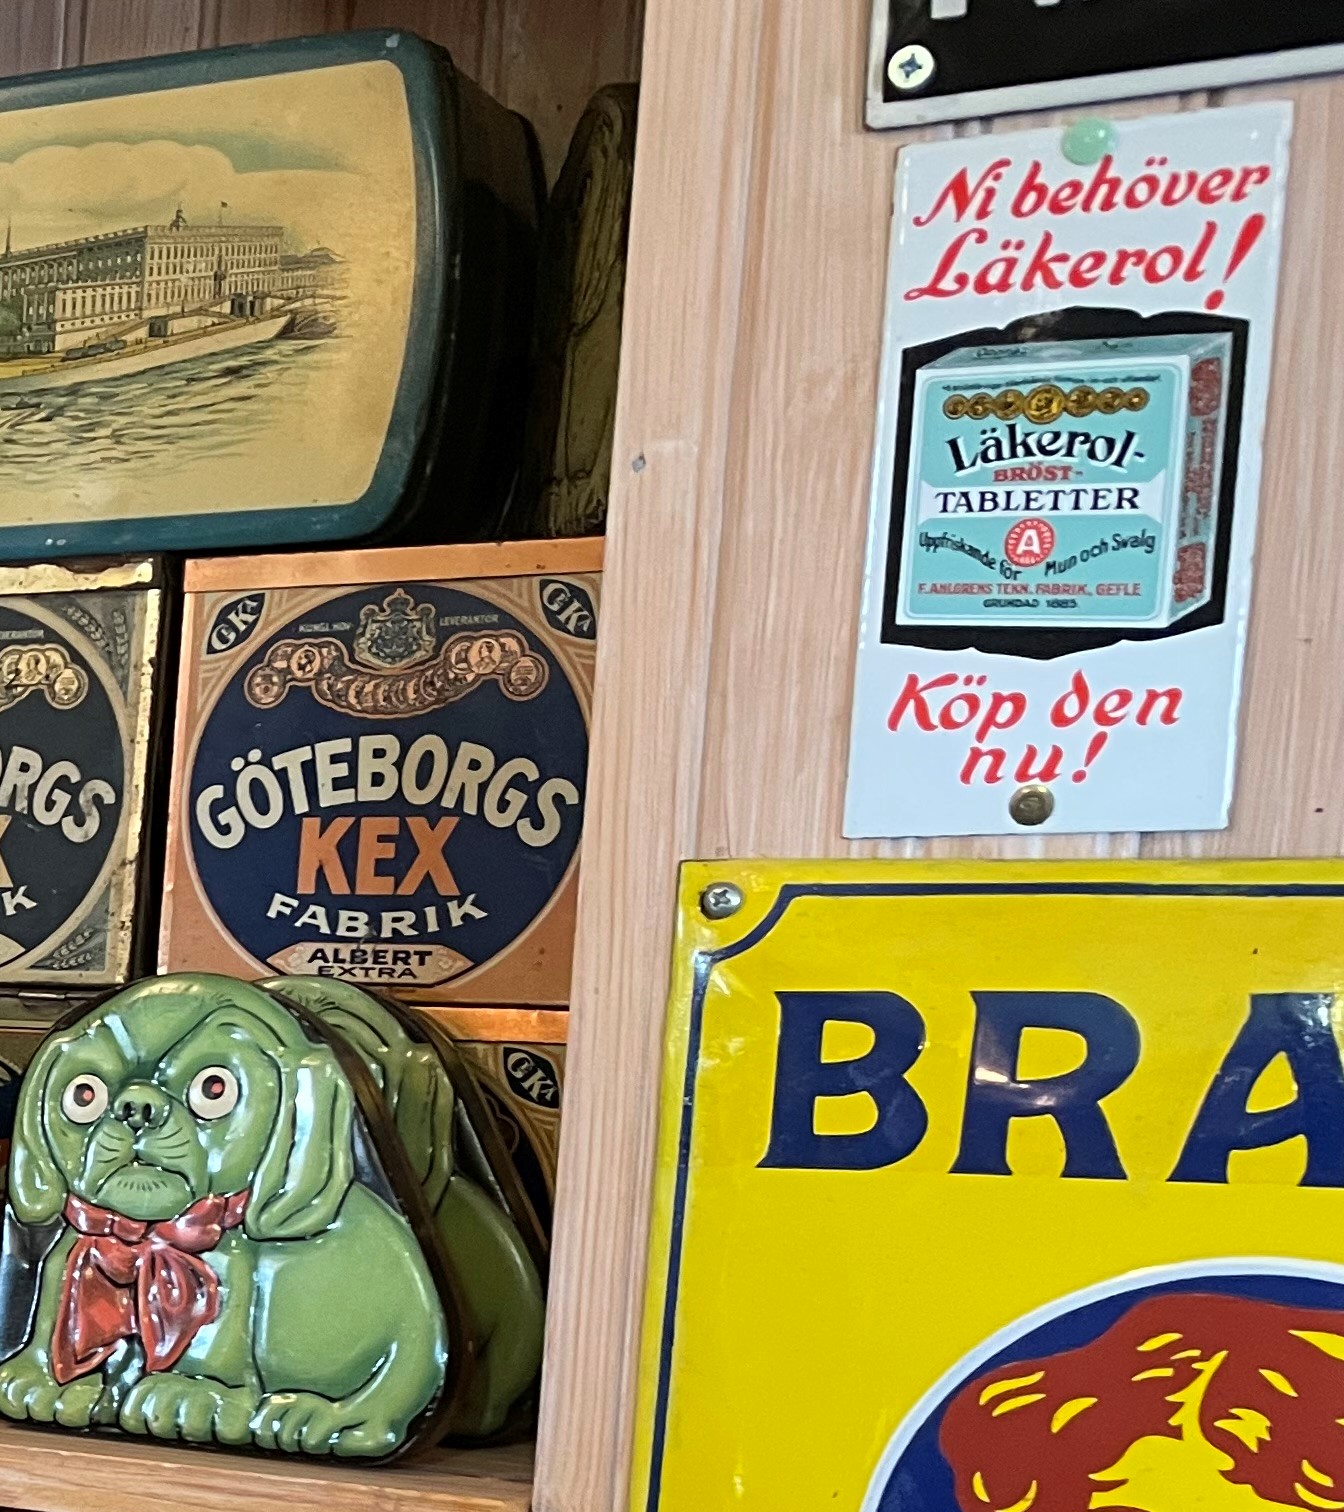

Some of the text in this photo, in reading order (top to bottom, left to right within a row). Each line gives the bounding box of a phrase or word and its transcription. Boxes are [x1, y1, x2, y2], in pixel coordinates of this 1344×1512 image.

[912, 154, 1272, 229] Ni behöver
[904, 213, 1268, 313] Läkerol!
[944, 423, 1146, 475] Läkerol-
[993, 461, 1084, 483] BRÖST-
[935, 487, 1140, 514] TABLETTER
[999, 560, 1023, 581] för
[1044, 557, 1078, 578] Mun
[1080, 538, 1110, 563] och
[1016, 529, 1042, 556] A
[1095, 582, 1141, 595] GEFLE
[887, 670, 1184, 743] Köp den
[960, 731, 1109, 786] nu!
[194, 733, 580, 849] GÖTEBORGS
[297, 816, 461, 897] KEX
[265, 892, 489, 939] FABRIK
[307, 948, 434, 967] ALBERT
[317, 965, 418, 980] EXTRA
